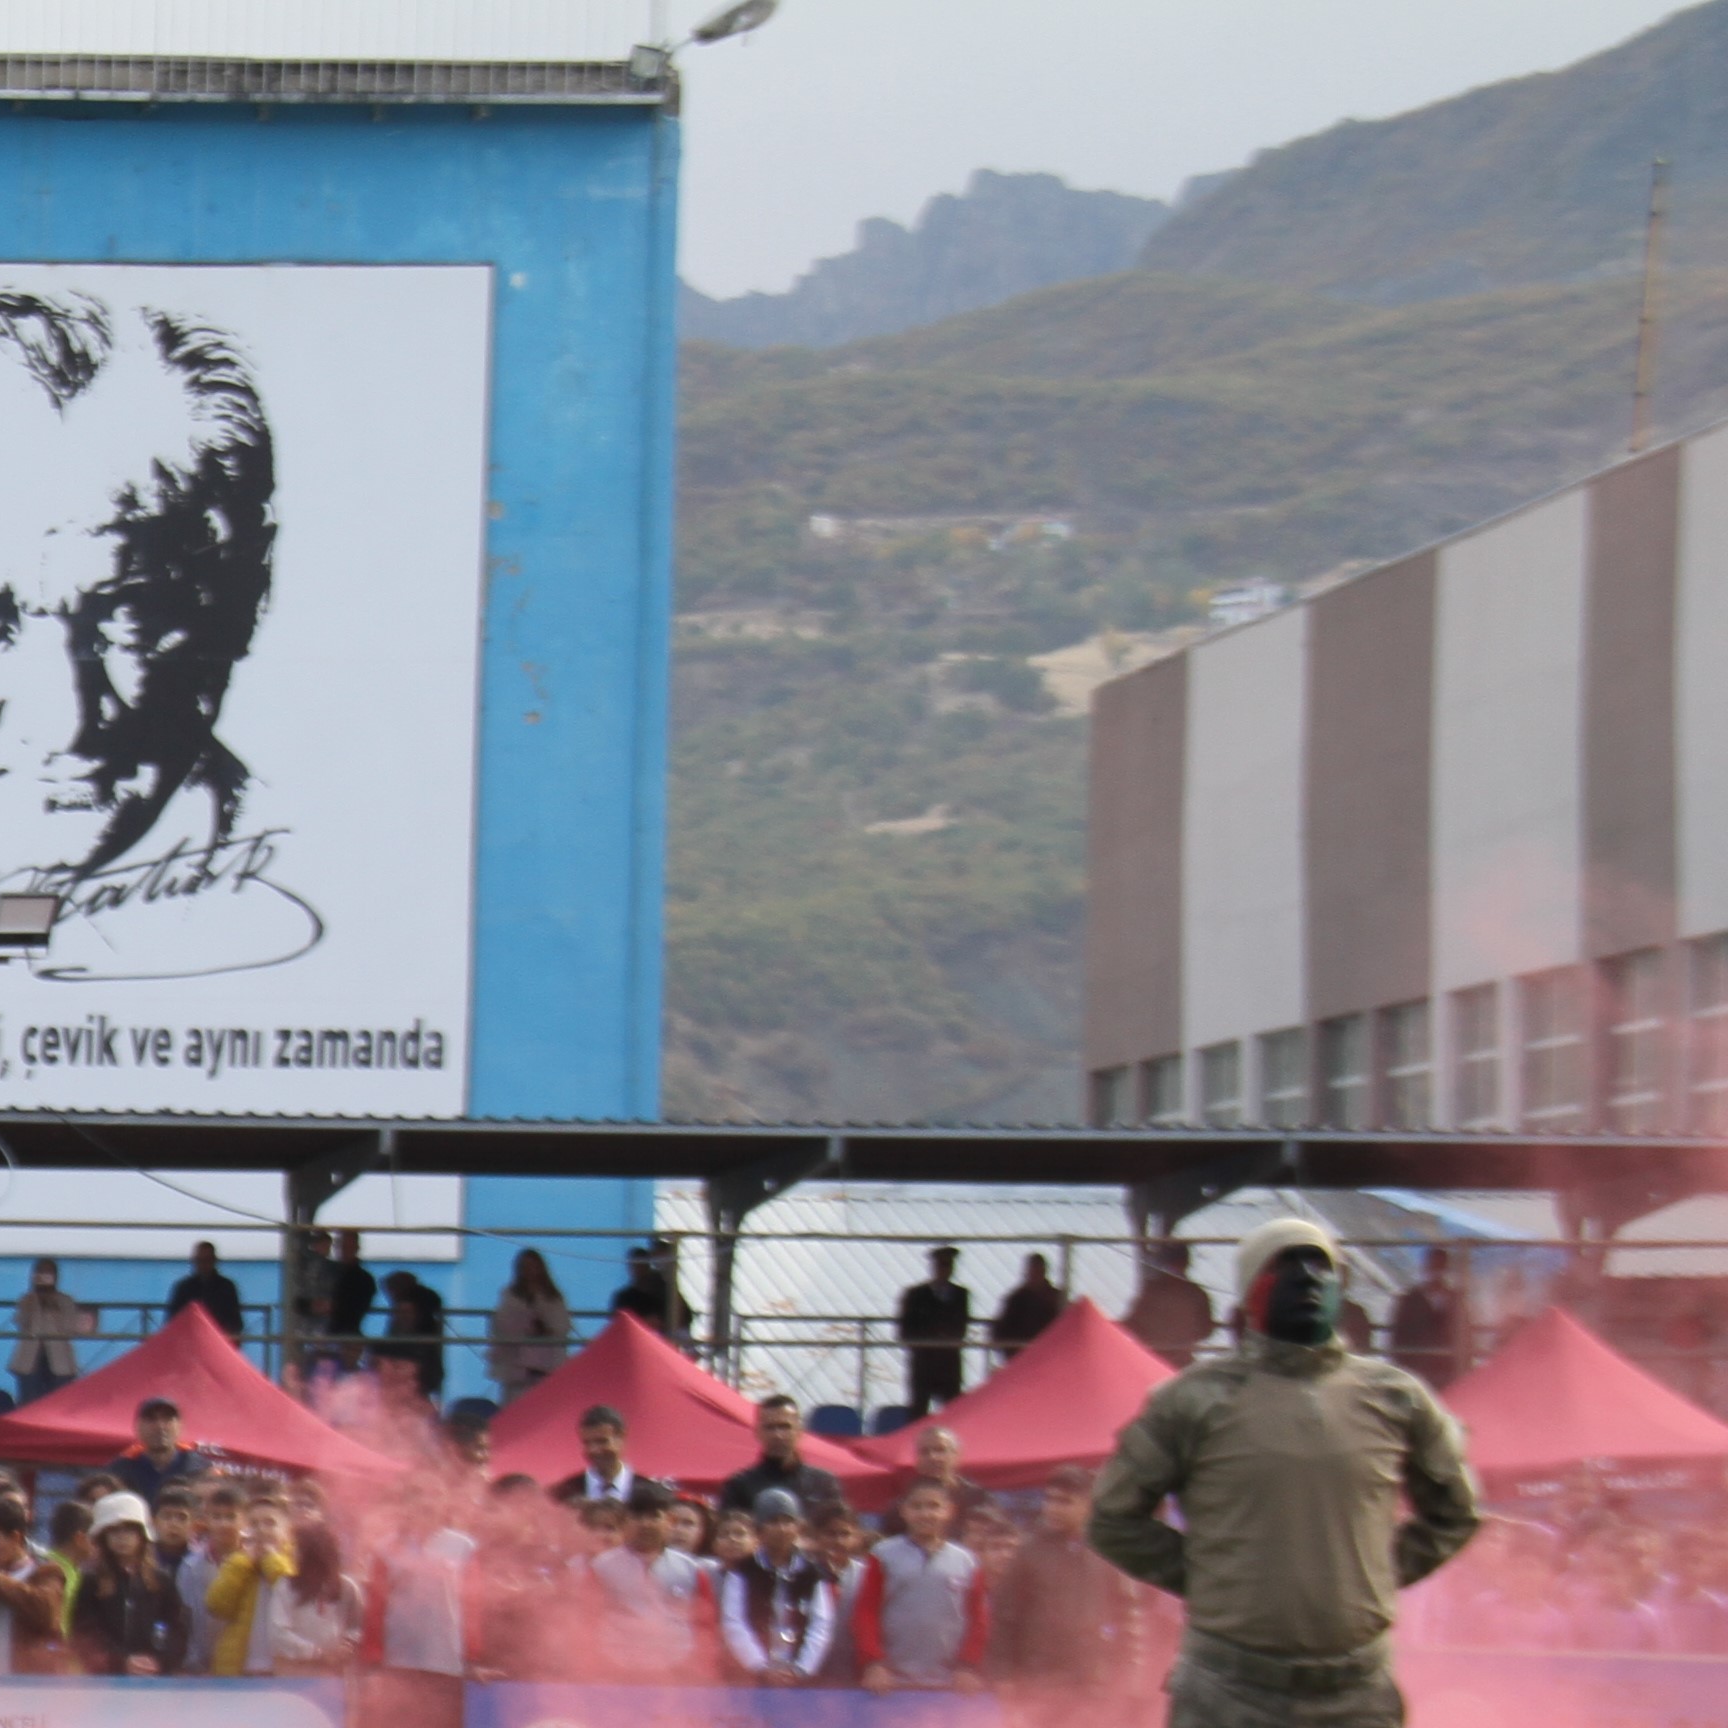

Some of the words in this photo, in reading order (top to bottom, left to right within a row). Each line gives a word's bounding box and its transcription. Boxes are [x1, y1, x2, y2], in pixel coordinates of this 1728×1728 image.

[19, 1013, 119, 1079] çevik
[130, 1024, 173, 1068] ve
[183, 1024, 262, 1079] aynı
[272, 1017, 445, 1069] zamanda
